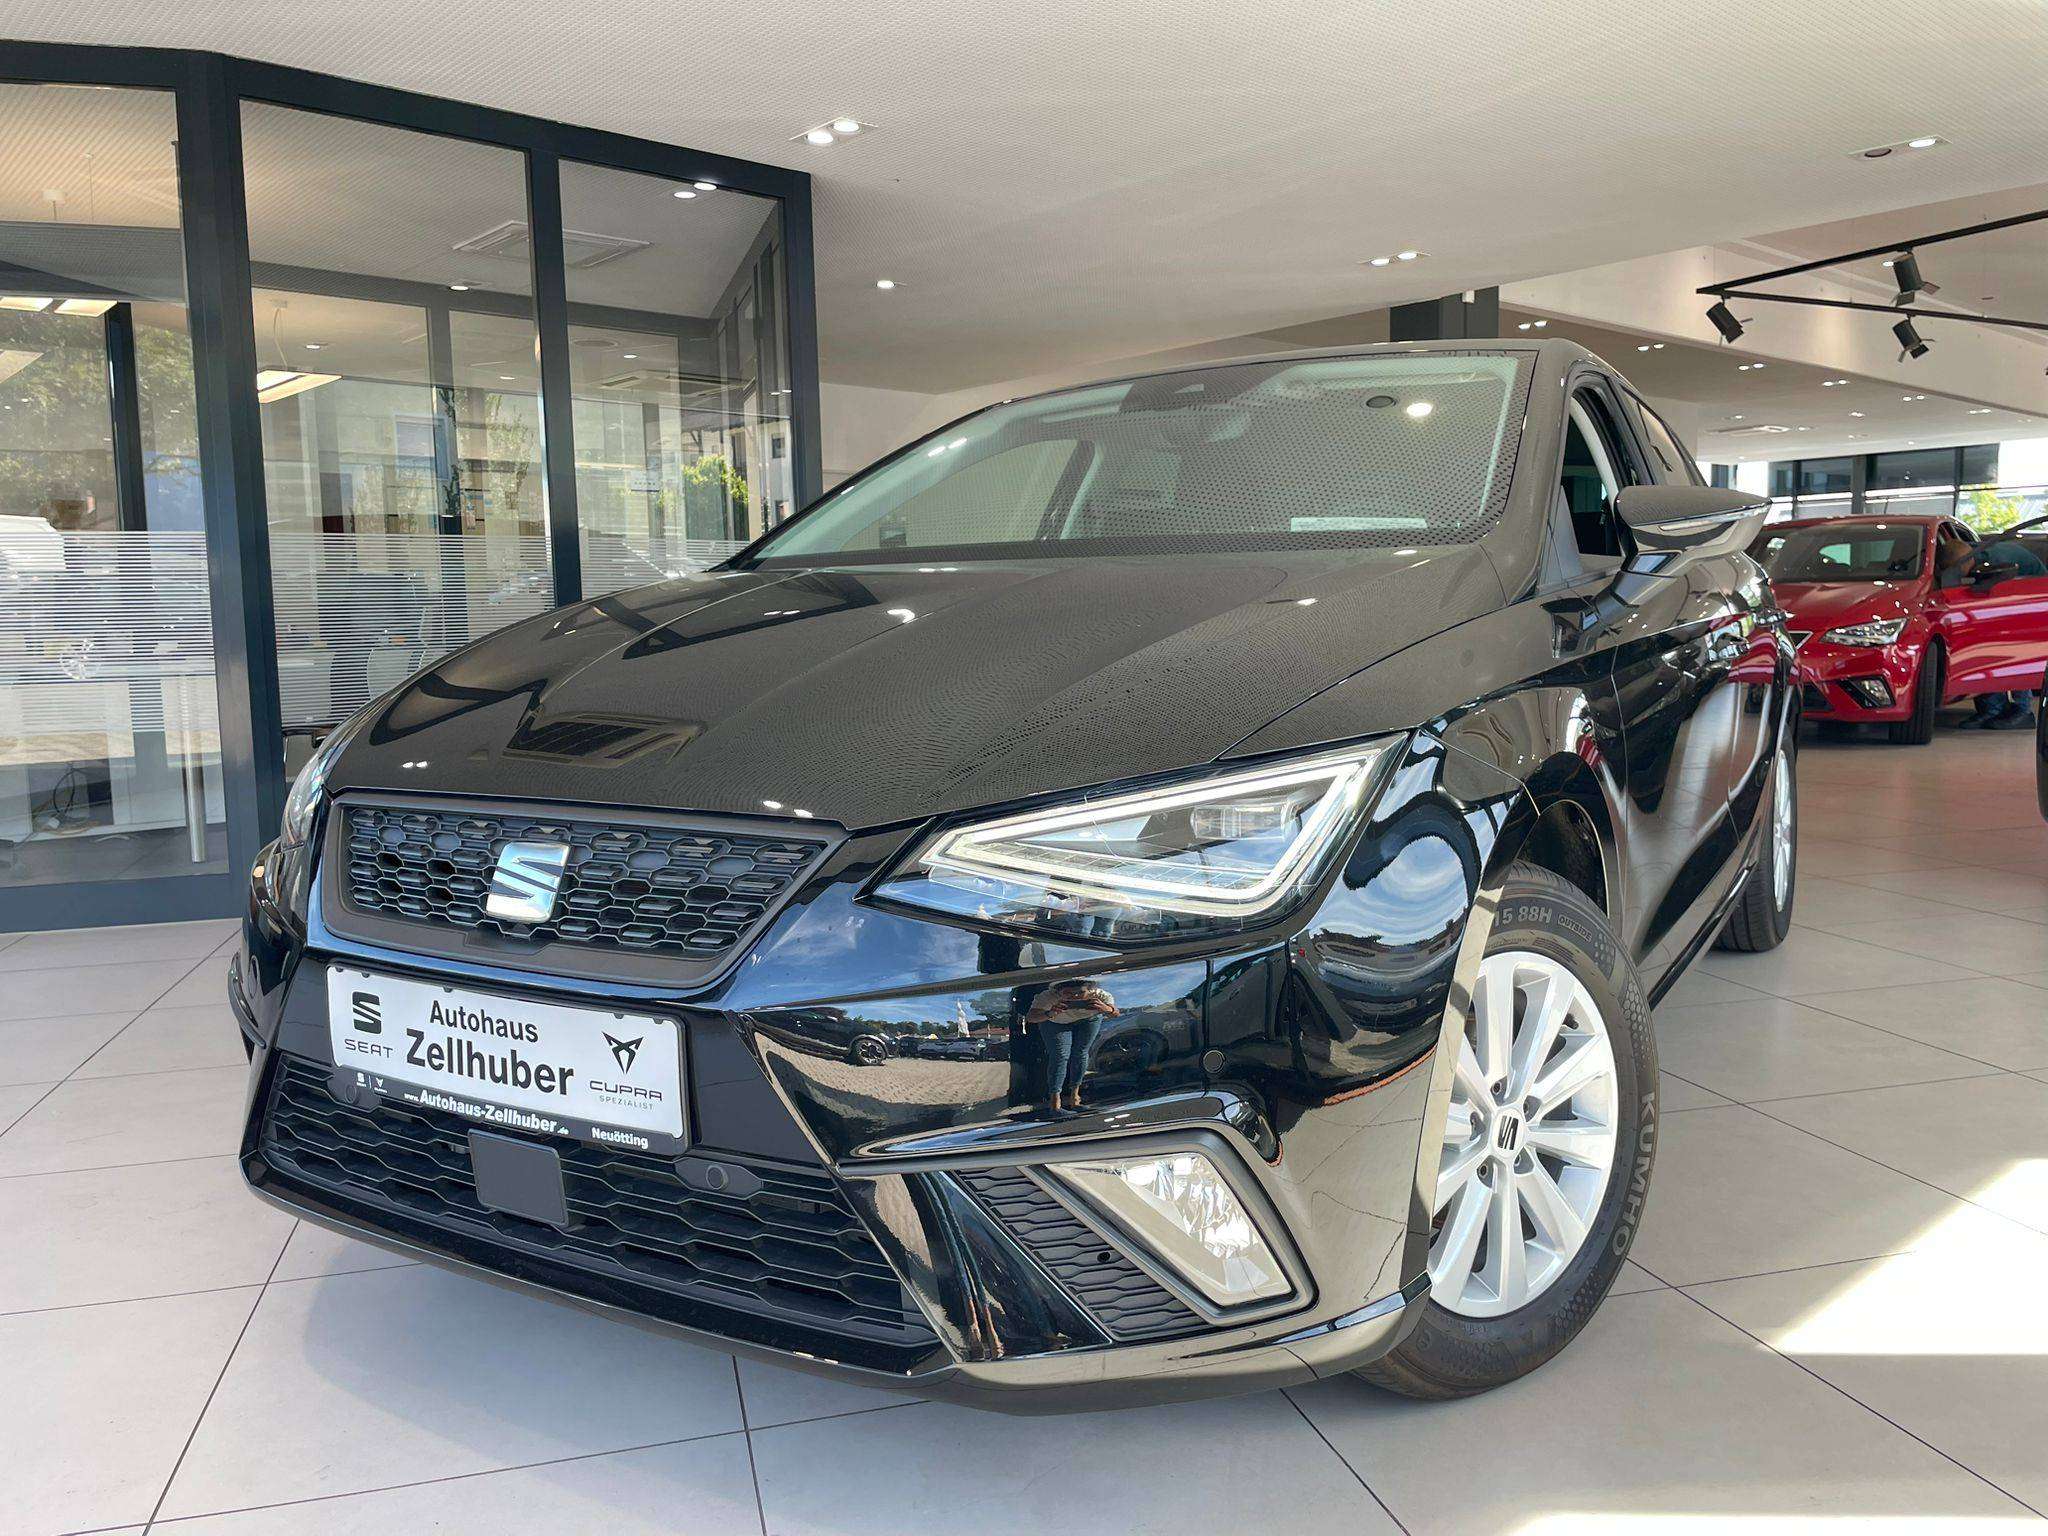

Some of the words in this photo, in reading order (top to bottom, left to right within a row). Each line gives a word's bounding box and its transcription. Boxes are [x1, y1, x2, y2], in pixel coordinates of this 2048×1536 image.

[1517, 905, 1552, 924] 88H
[1558, 913, 1593, 943] OUTSIDE
[429, 1000, 539, 1043] Autohaus
[344, 1038, 394, 1059] SEAT
[406, 1028, 574, 1096] Zellhuber
[589, 1080, 663, 1102] CUPRA
[599, 1094, 655, 1111] SPEZIALIST
[591, 1127, 649, 1150] Neuötting
[1612, 1092, 1656, 1256] KUMHO
